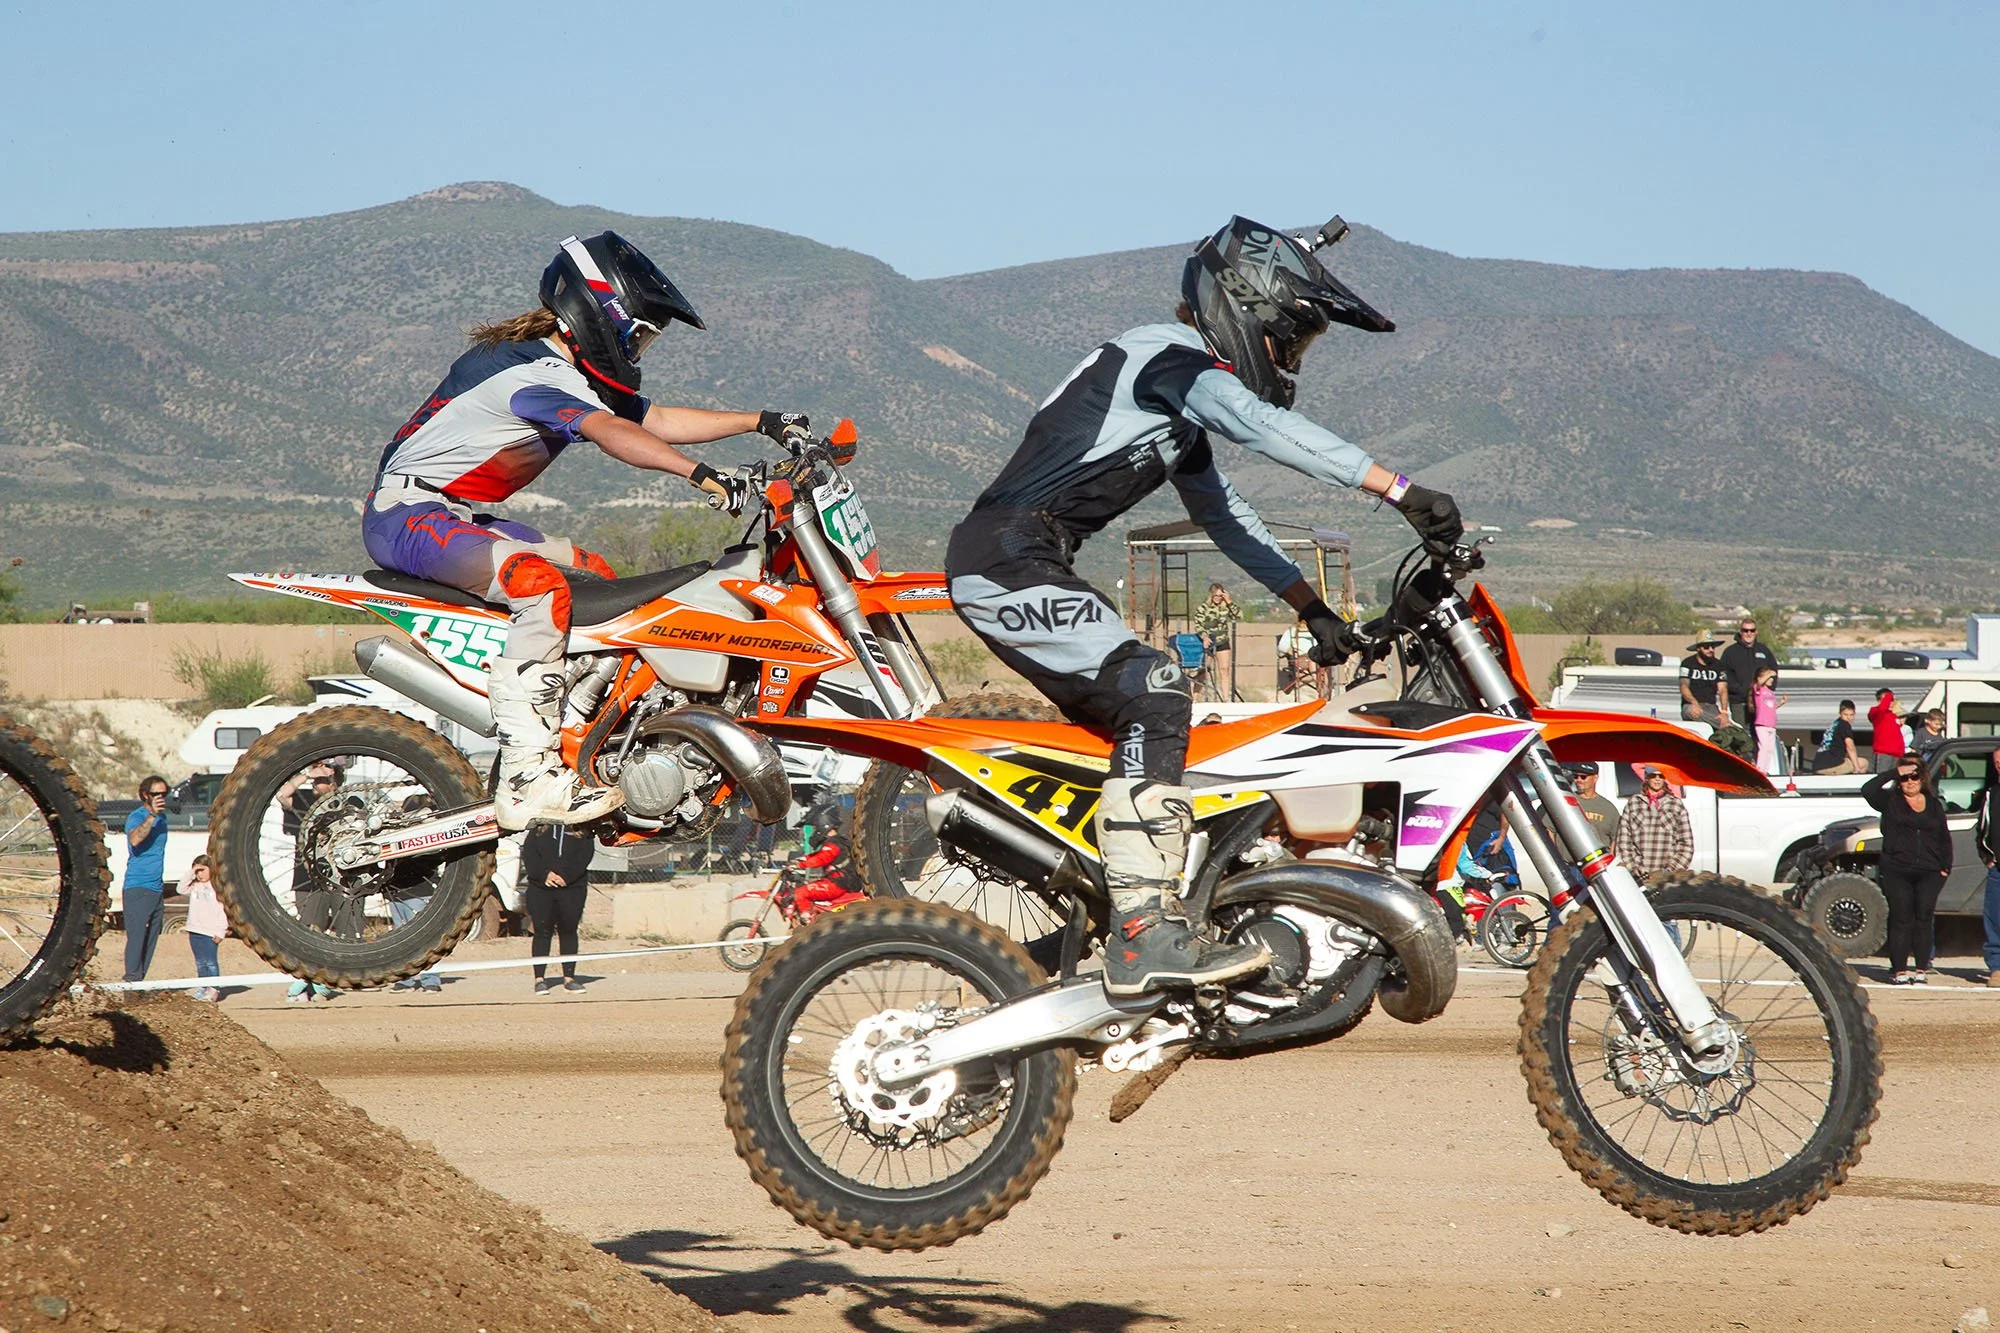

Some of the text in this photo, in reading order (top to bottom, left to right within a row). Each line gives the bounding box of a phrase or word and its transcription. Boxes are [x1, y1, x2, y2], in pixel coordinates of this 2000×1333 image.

[1294, 441, 1318, 456] RACING
[276, 584, 332, 599] DUNLOP
[648, 624, 726, 645] ALCHEMY
[410, 615, 508, 670] 155
[1691, 669, 1718, 680] DAD
[1006, 774, 1101, 849] 41
[1405, 814, 1444, 829] KTM
